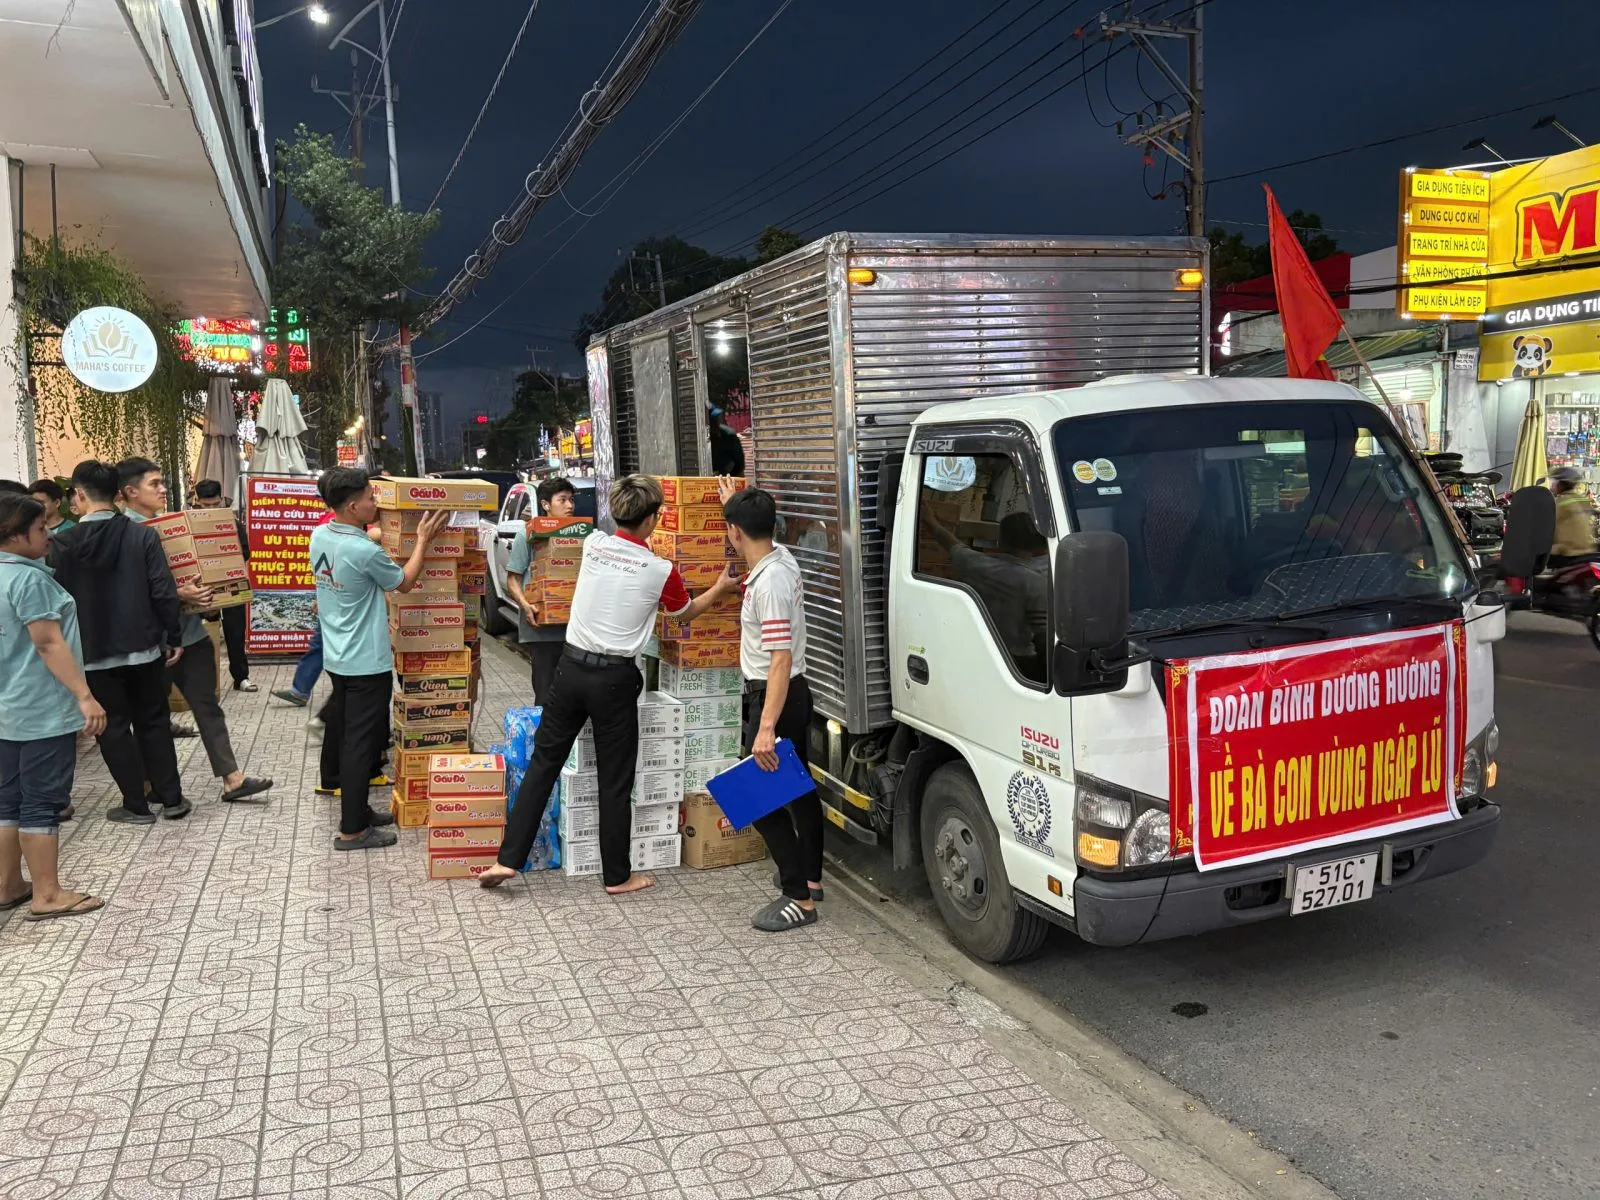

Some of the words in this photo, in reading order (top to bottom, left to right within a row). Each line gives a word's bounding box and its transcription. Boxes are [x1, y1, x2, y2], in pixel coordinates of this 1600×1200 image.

[1417, 180, 1430, 192] GIA
[1432, 182, 1453, 196] DỤNG
[1455, 181, 1471, 197] TIỆN
[1473, 182, 1486, 196] ÍCH
[1420, 209, 1442, 224] DỤNG
[1443, 211, 1454, 225] CỤ
[1455, 211, 1466, 223] CƠ
[1468, 210, 1480, 224] KHÍ
[1412, 238, 1438, 250] TRANG
[1440, 237, 1452, 250] TRÍ
[1454, 237, 1469, 251] NHÀ
[1471, 237, 1486, 252] CỬA
[1415, 264, 1431, 277] VĂN
[1433, 264, 1459, 279] PHÒNG
[1413, 295, 1429, 309] PHỤ
[1431, 292, 1448, 309] KIỆN
[1450, 293, 1465, 307] LÀM
[1467, 296, 1482, 310] ĐẸP
[1505, 308, 1532, 324] GIA
[1534, 301, 1580, 321] DỤNG
[76, 361, 110, 372] MAHA'S
[112, 363, 146, 373] COFFEE
[263, 483, 278, 491] HP
[409, 487, 432, 499] Gấu
[432, 487, 447, 499] Đỏ
[278, 496, 298, 506] TIẾP
[251, 508, 281, 518] HÀNG
[283, 509, 305, 519] CỨU
[251, 521, 262, 530] LŨ
[263, 523, 278, 531] LỤT
[263, 534, 283, 545] ƯU
[275, 549, 295, 559] YẾU
[296, 551, 311, 559] PH
[250, 561, 285, 573] THỰC
[256, 572, 293, 585] THIẾT
[249, 633, 279, 641] KHÔNG
[281, 633, 305, 642] NHẬN
[680, 672, 703, 682] ALOE
[680, 683, 703, 691] FRESH
[1209, 685, 1265, 735] ĐOÀN
[1269, 679, 1315, 726] BÌNH
[1321, 670, 1380, 716] DƯƠNG
[1385, 656, 1440, 705] HƯỚNG
[684, 705, 701, 714] LOE
[686, 714, 701, 723] ESH
[1021, 725, 1059, 750] ISUZU
[685, 747, 703, 756] RESH
[1022, 749, 1047, 772] 91
[1048, 762, 1061, 777] PS
[433, 774, 453, 783] Gấu
[453, 774, 466, 783] Đỏ
[685, 769, 698, 779] OE
[1210, 741, 1235, 839] VỀ
[1241, 749, 1267, 833] BÀ
[1273, 754, 1312, 826] CON
[1318, 735, 1366, 817] VÙNG
[1372, 722, 1417, 815] NGẬP
[1421, 715, 1442, 795] LŨ
[435, 803, 455, 812] Gấu
[454, 804, 468, 812] Đỏ
[433, 830, 452, 838] Gấu
[1319, 861, 1355, 885] 51C
[1301, 880, 1364, 911] 527.01
